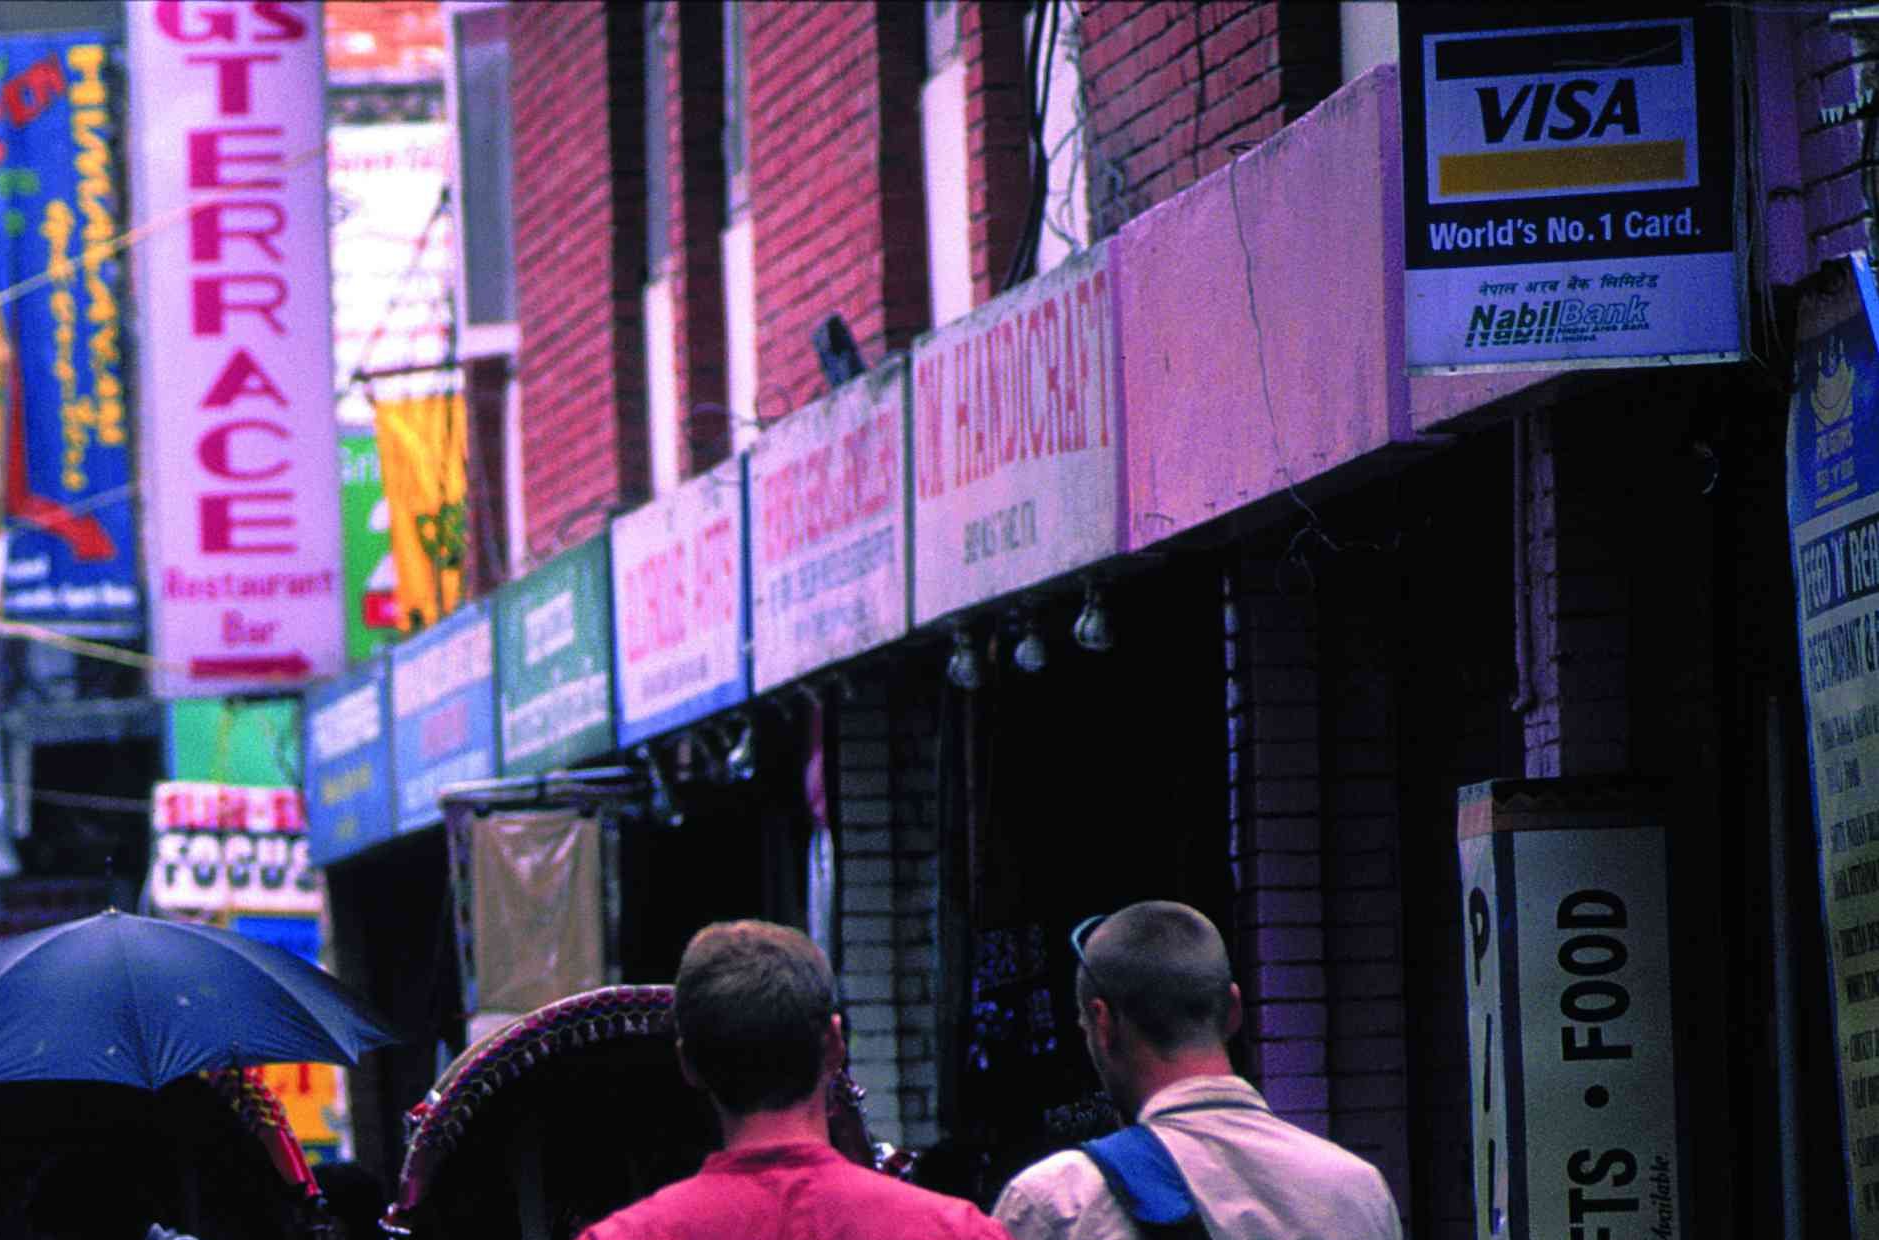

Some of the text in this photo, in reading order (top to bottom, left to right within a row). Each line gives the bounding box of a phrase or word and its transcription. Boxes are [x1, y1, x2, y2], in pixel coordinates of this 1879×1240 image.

[1474, 78, 1641, 144] VISA
[1429, 218, 1538, 250] World's
[1624, 208, 1702, 239] Card.
[184, 51, 297, 555] TERRACE
[1479, 281, 1518, 296] नेपाल
[1525, 280, 1560, 294] अरब
[1557, 889, 1632, 1062] FOOD
